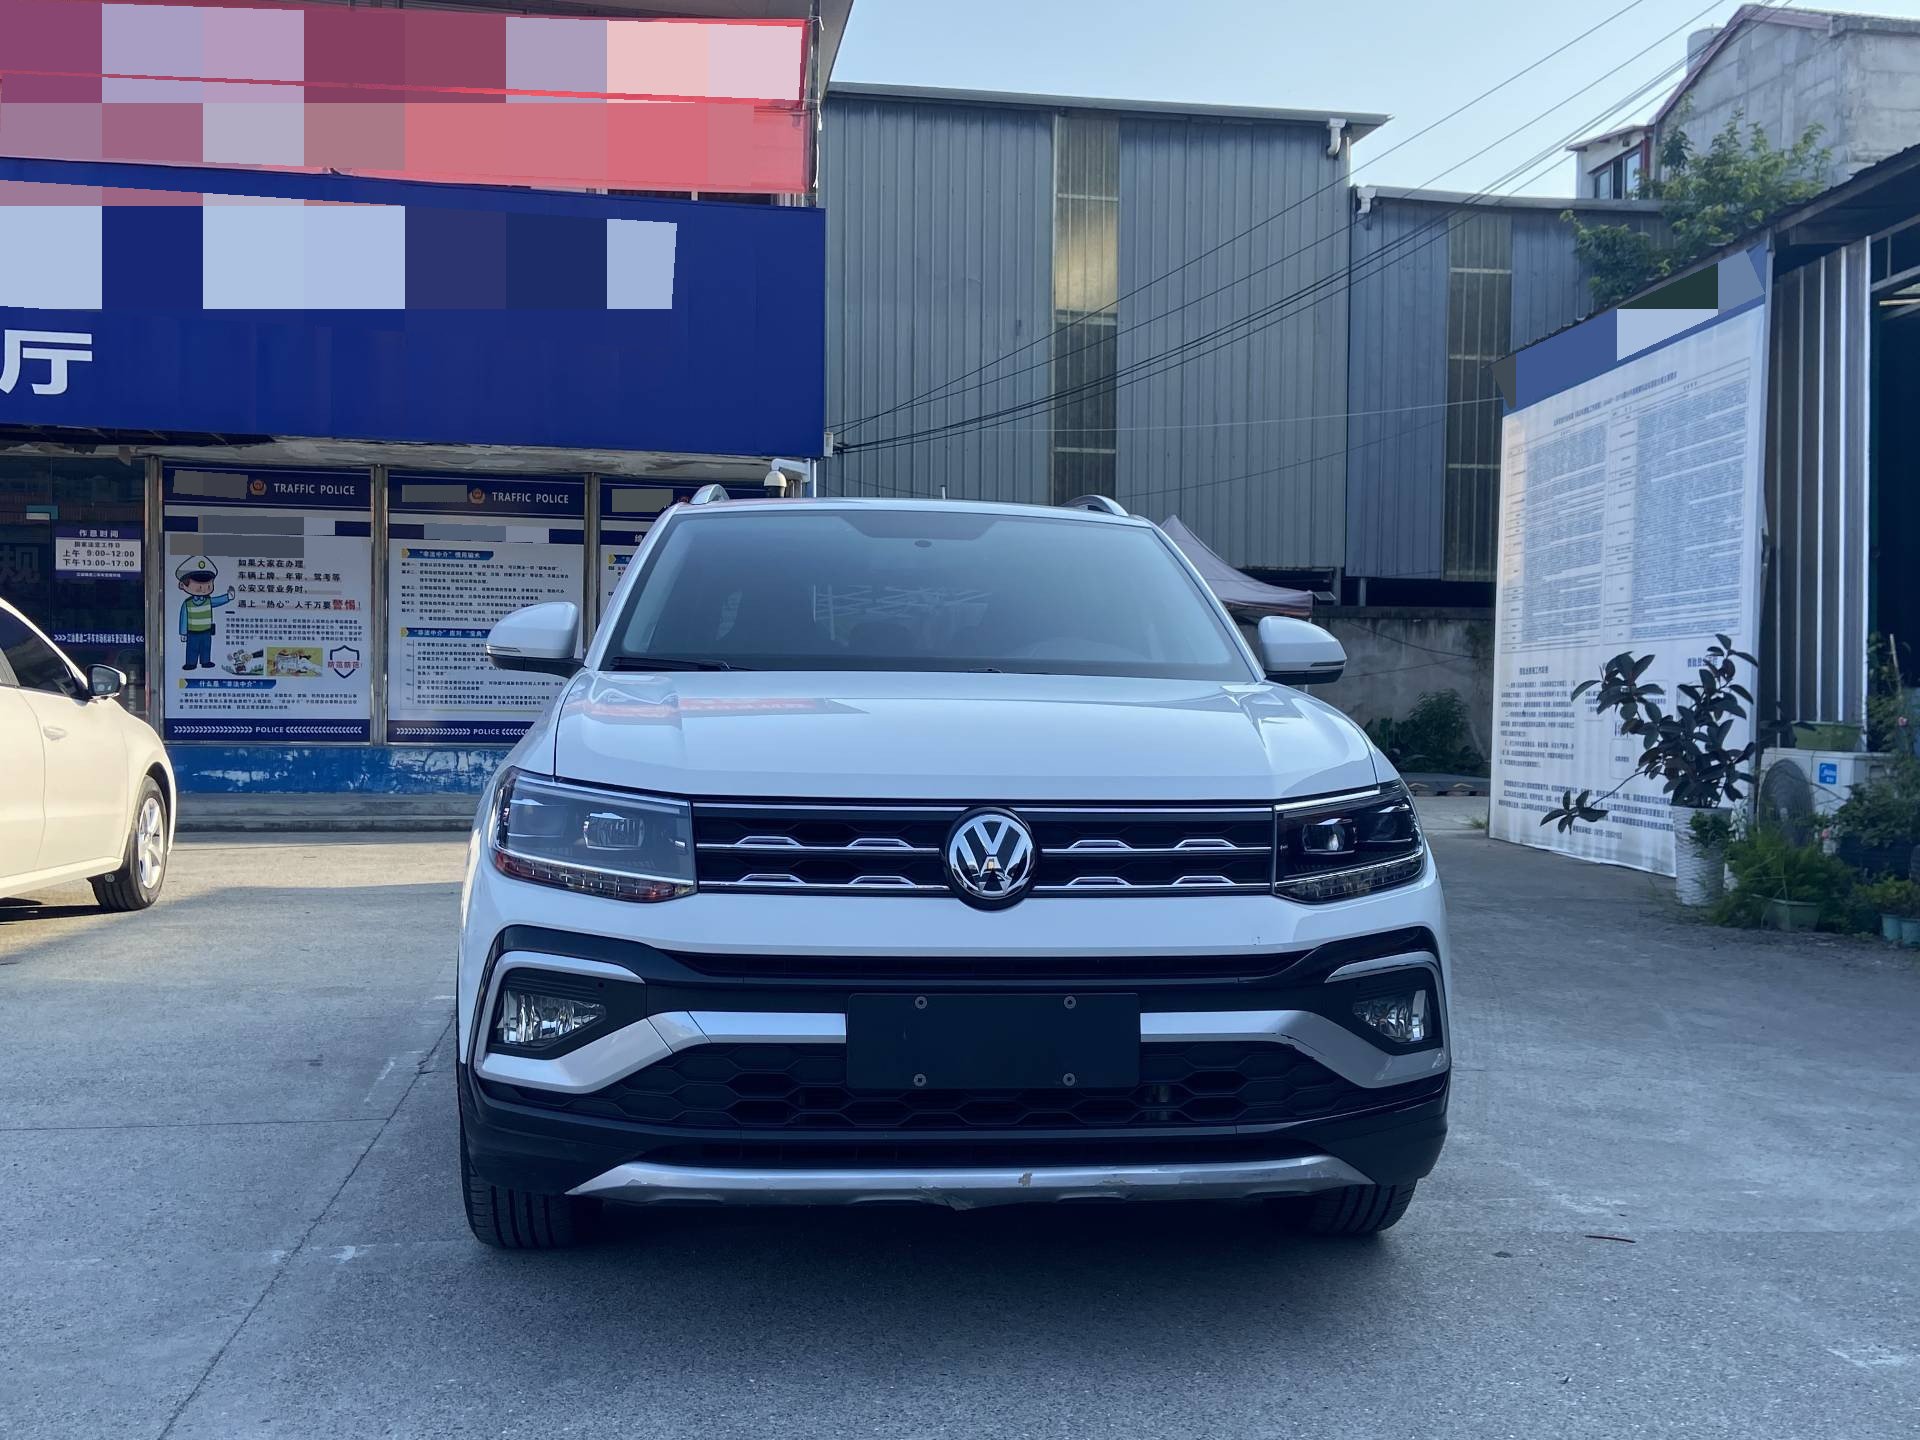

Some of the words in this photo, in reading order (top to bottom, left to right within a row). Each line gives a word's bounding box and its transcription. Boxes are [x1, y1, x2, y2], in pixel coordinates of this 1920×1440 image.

[0, 329, 92, 395] 厅
[274, 483, 316, 494] TRAFFIC
[320, 485, 355, 495] POLICE
[492, 492, 532, 502] TRAFFIC
[536, 494, 569, 504] POLICE
[63, 549, 81, 558] 上午
[238, 559, 304, 569] 如果大家在办理
[255, 726, 285, 734] POLICE
[473, 728, 500, 736] POLICE
